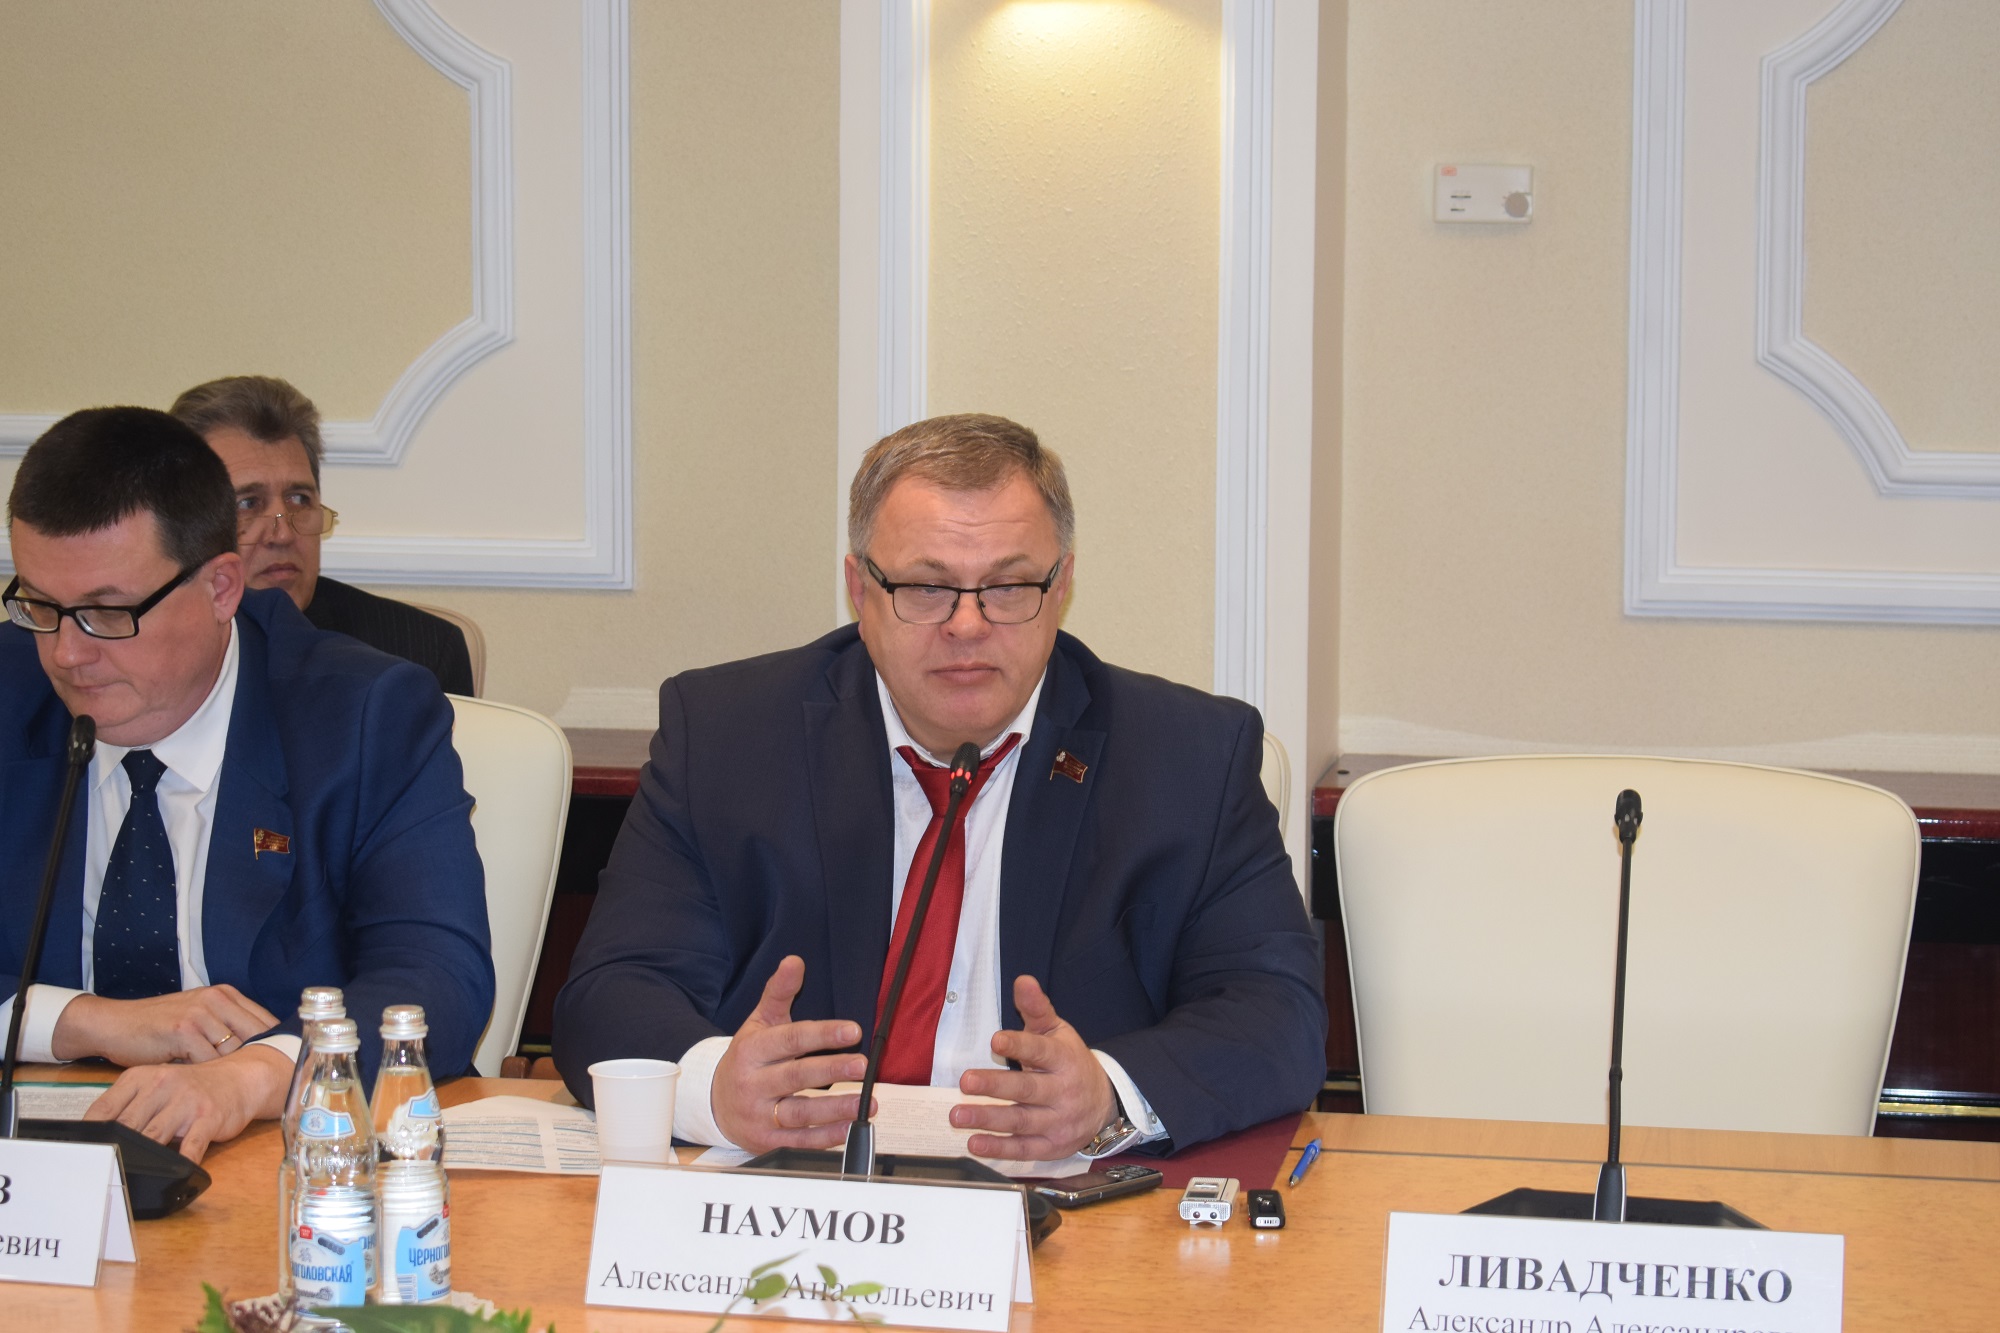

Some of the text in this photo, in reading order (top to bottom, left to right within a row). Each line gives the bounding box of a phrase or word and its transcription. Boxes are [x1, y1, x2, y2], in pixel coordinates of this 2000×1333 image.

[700, 1201, 906, 1245] НАУМОВ
[0, 1234, 62, 1258] вич
[781, 1272, 996, 1312] Анаольевич
[1438, 1253, 1793, 1304] ЛИВАДЧЕНКО
